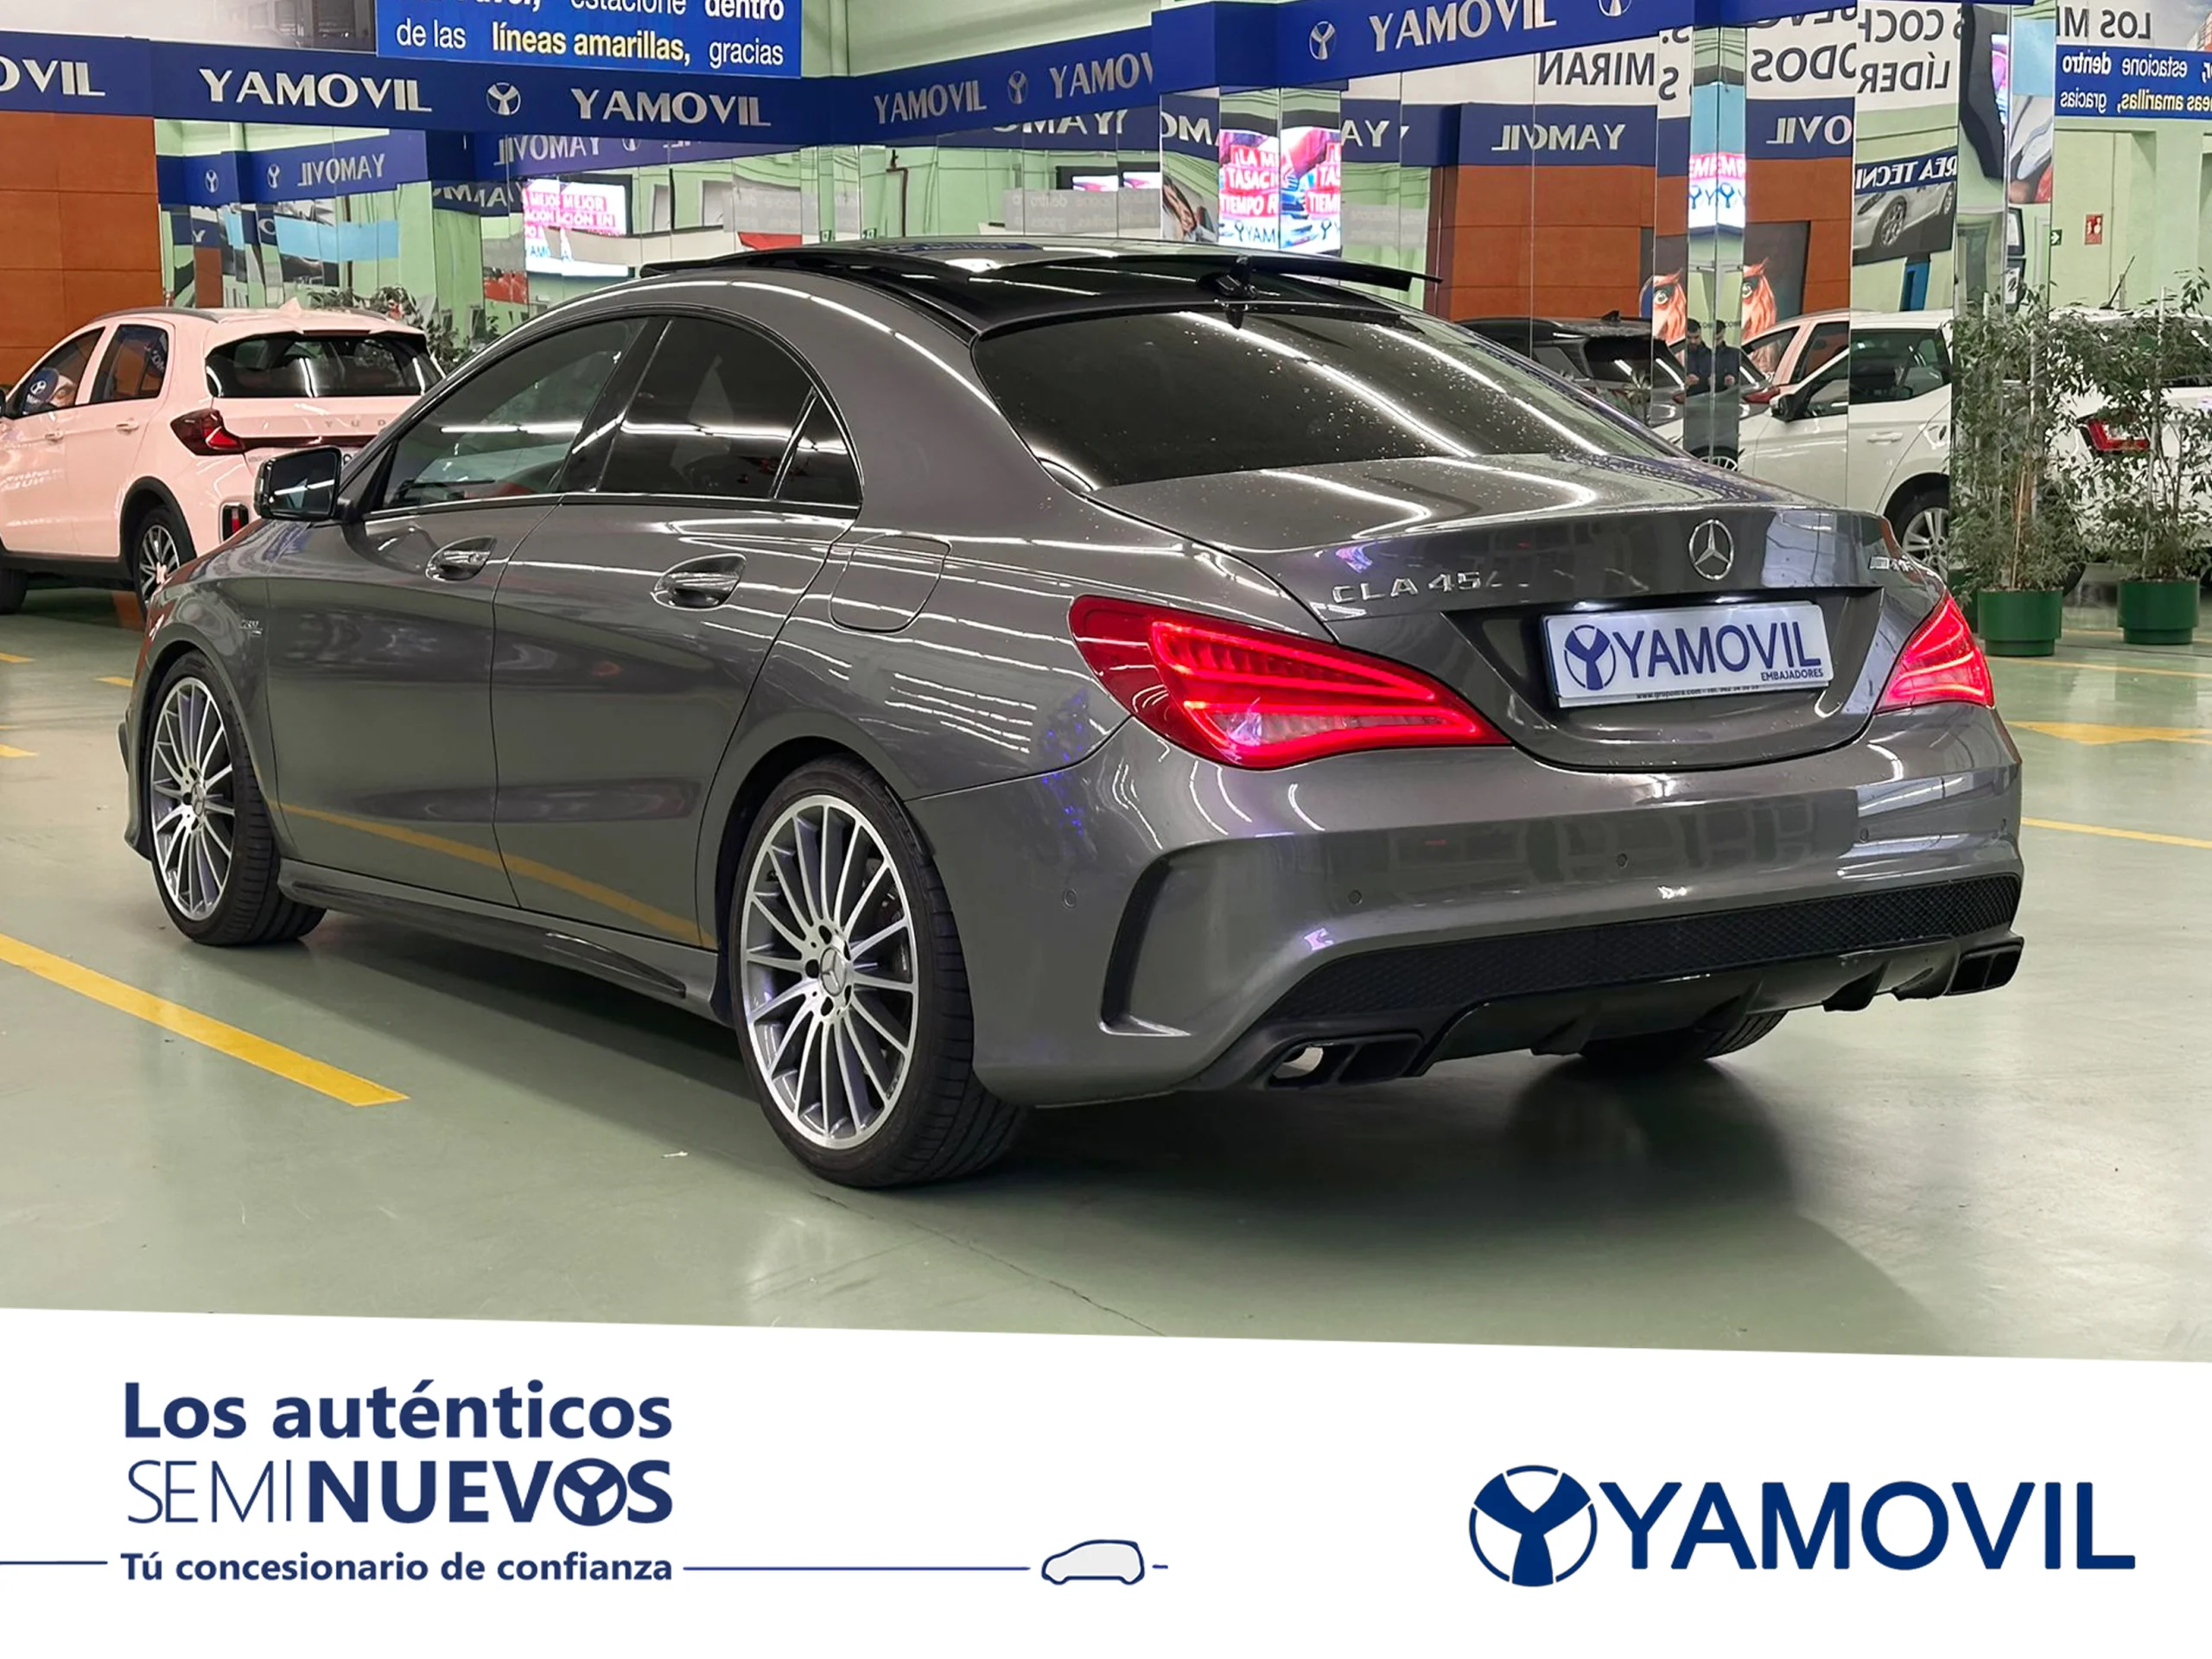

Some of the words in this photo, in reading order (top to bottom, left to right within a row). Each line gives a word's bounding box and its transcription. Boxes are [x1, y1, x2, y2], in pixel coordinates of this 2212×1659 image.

[396, 17, 426, 47] de
[434, 19, 467, 48] las
[493, 21, 567, 54] líneas
[574, 30, 691, 67] amarillas,
[709, 38, 784, 69] gracias
[1369, 0, 1557, 52] YAMOVIL
[199, 68, 432, 112] YAMOVIL
[570, 88, 772, 126] YAMOVIL
[874, 79, 987, 124] YAMOVIL
[1332, 577, 1419, 604] CLA
[1428, 571, 1481, 593] 45
[1612, 621, 1821, 678] YAMOVIL
[1761, 668, 1824, 682] EMBAJADORES
